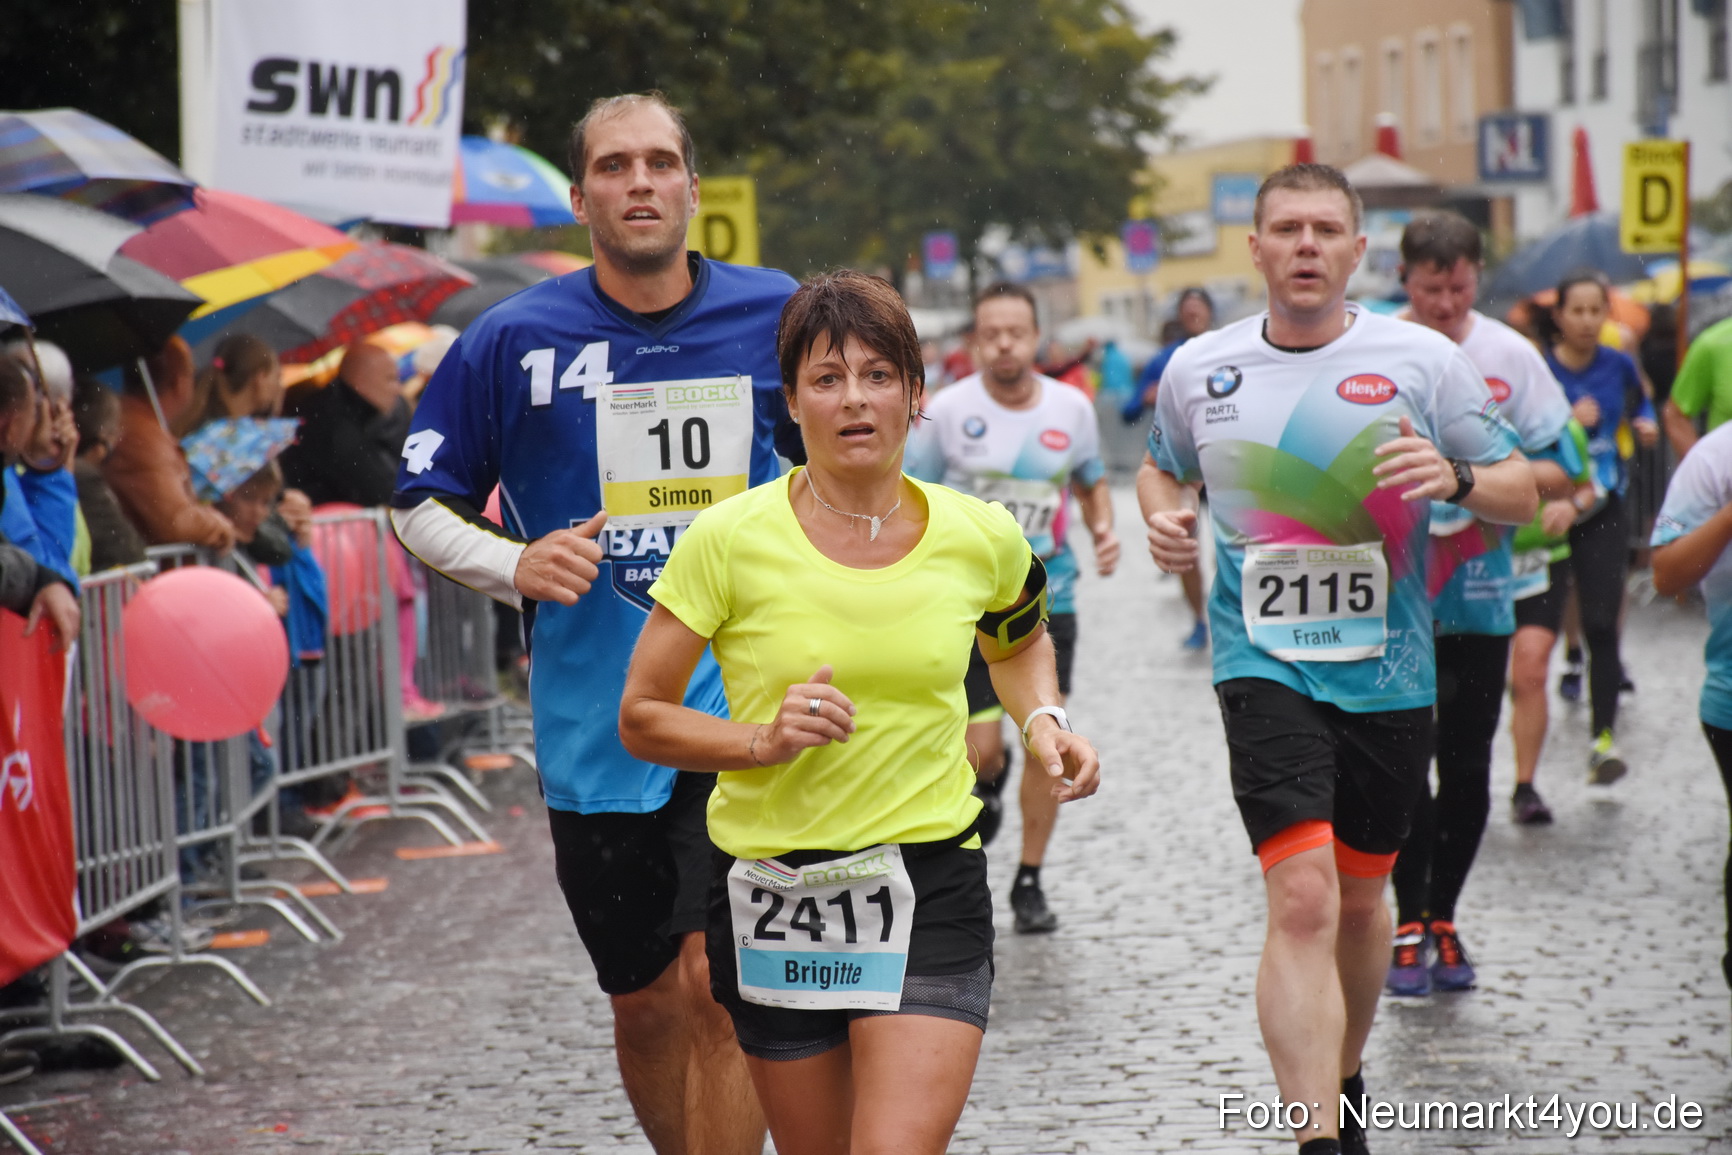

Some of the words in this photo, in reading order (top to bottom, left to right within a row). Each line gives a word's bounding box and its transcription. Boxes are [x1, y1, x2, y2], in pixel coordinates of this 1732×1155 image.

[247, 58, 401, 123] swn
[1640, 175, 1672, 225] D
[703, 213, 738, 261] D
[520, 340, 613, 406] 14
[1344, 381, 1392, 398] Hervis
[610, 400, 657, 410] NeuerMarkt
[666, 384, 739, 404] BOCK
[1206, 404, 1239, 417] PARTL
[648, 416, 710, 470] 10
[649, 486, 712, 507] Simon
[1307, 548, 1374, 563] BOCK
[1259, 572, 1374, 618] 2115
[1293, 626, 1342, 646] Frank
[803, 852, 893, 888] BOCK
[751, 886, 894, 943] 2411
[785, 960, 862, 990] Brigitte
